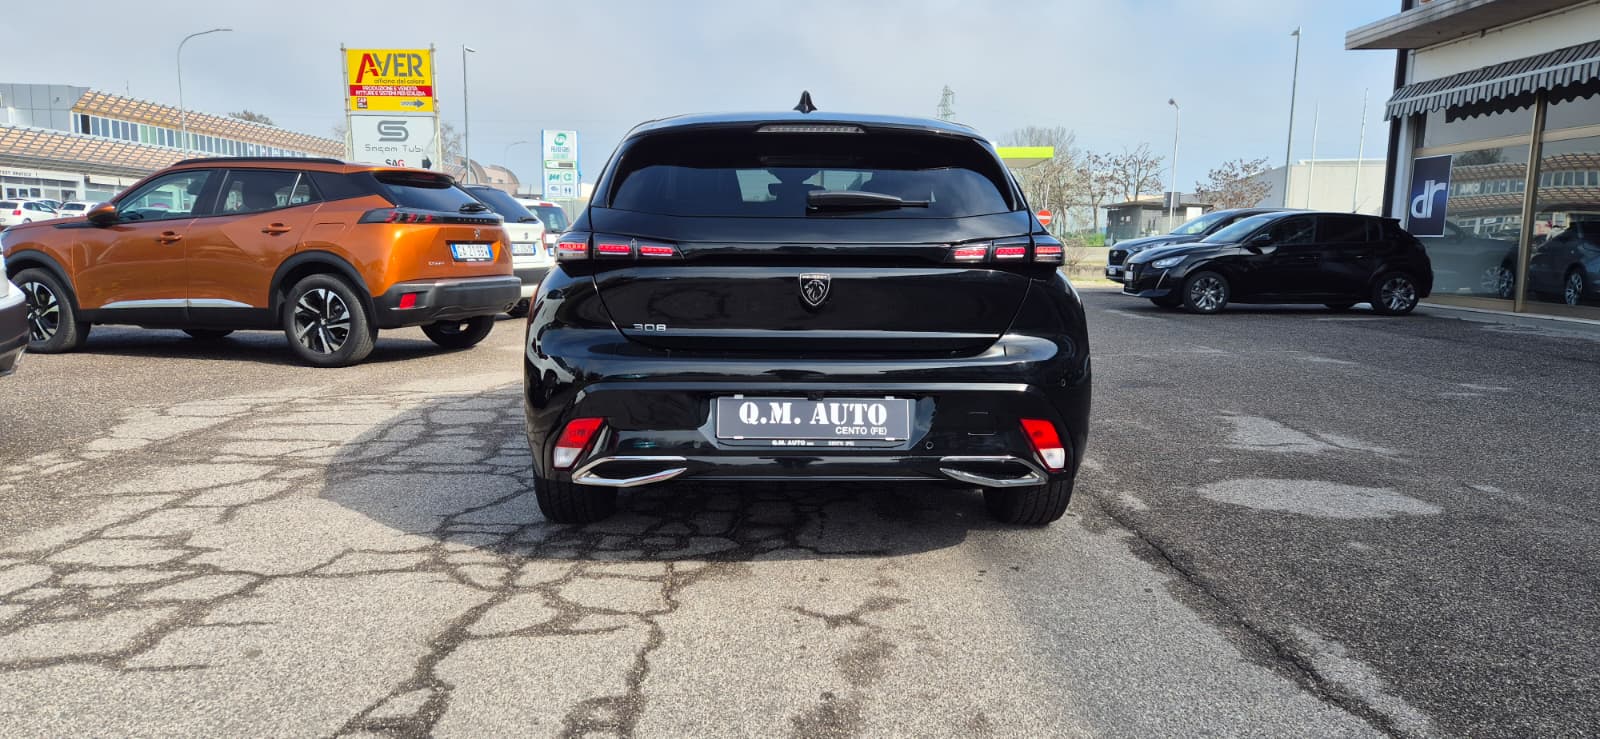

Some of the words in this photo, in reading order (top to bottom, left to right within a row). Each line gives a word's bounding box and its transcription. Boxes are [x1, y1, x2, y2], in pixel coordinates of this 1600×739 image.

[356, 53, 423, 83] AVER
[1411, 180, 1447, 218] dr
[633, 324, 666, 332] 308
[739, 401, 801, 425] Q.M.
[810, 402, 887, 426] AUTO
[835, 426, 868, 436] CENTO
[870, 426, 887, 436] (FE)
